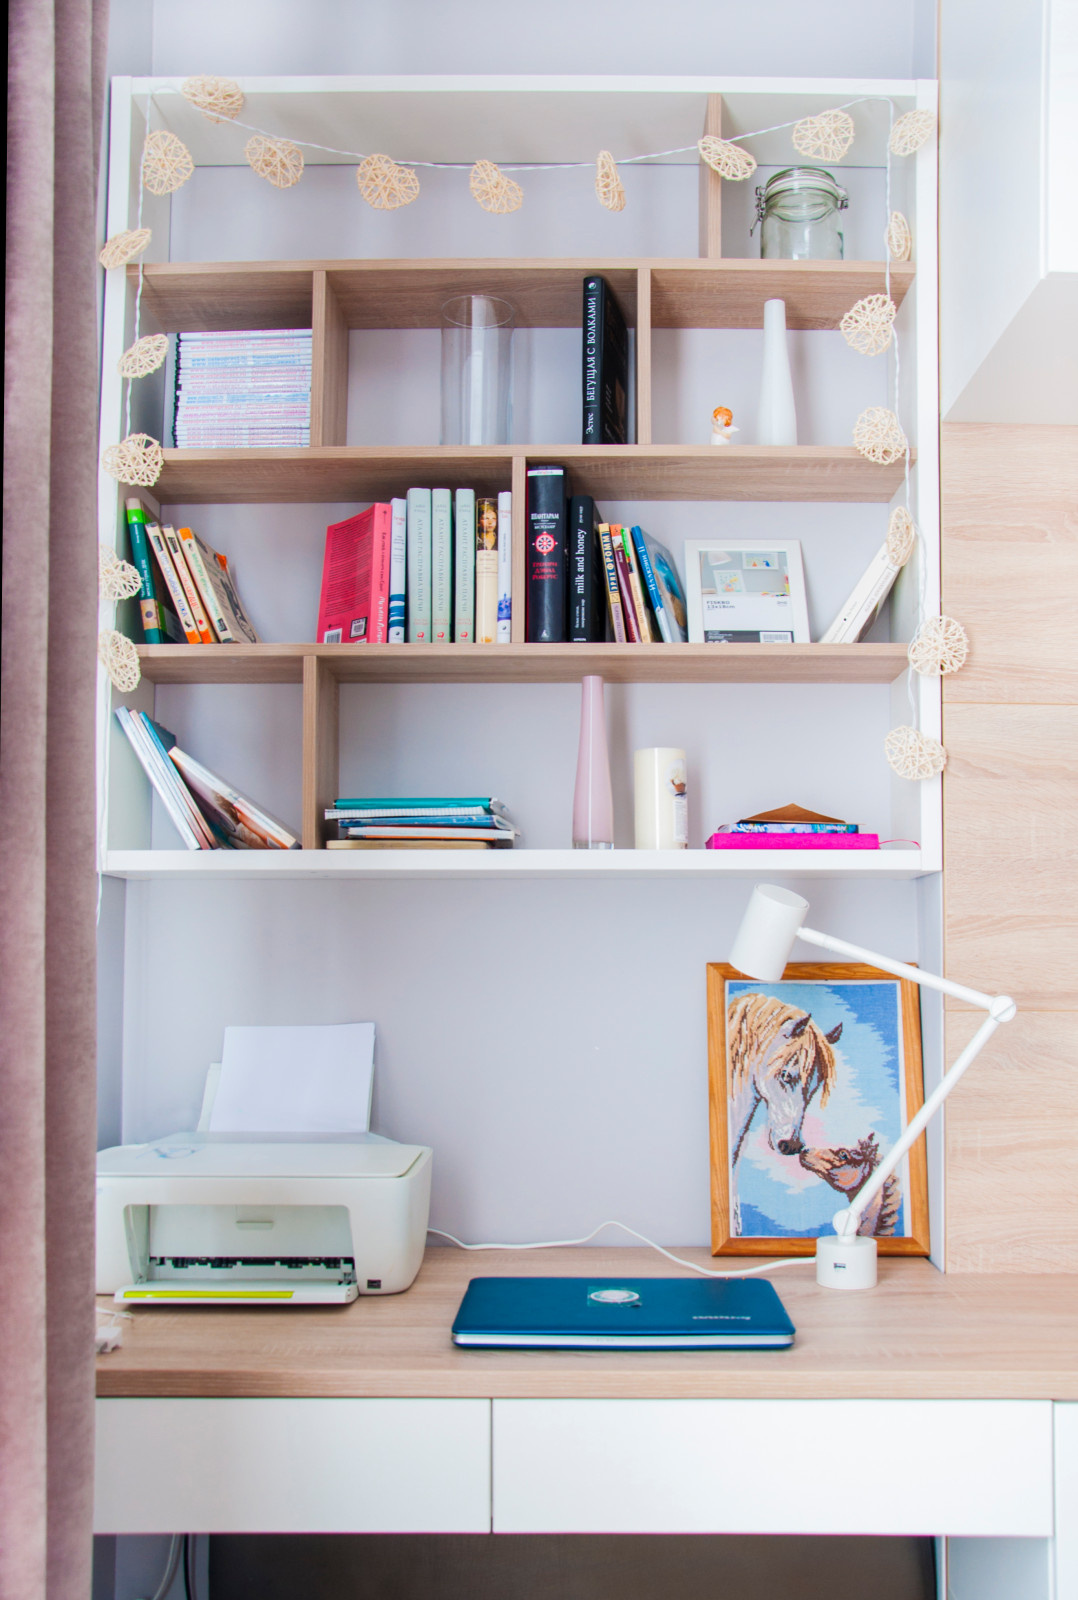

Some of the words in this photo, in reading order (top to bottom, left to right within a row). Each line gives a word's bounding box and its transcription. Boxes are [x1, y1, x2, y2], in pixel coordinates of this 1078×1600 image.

[587, 297, 597, 344] ВОЛКАМИ
[587, 347, 596, 355] С
[586, 357, 598, 401] БЕГУЩАЯ
[576, 528, 587, 555] honey
[602, 535, 613, 571] ФРОММ
[576, 556, 585, 572] and
[576, 574, 585, 594] milk
[608, 571, 619, 592] ЭРИХ
[176, 598, 188, 618] КОЖА
